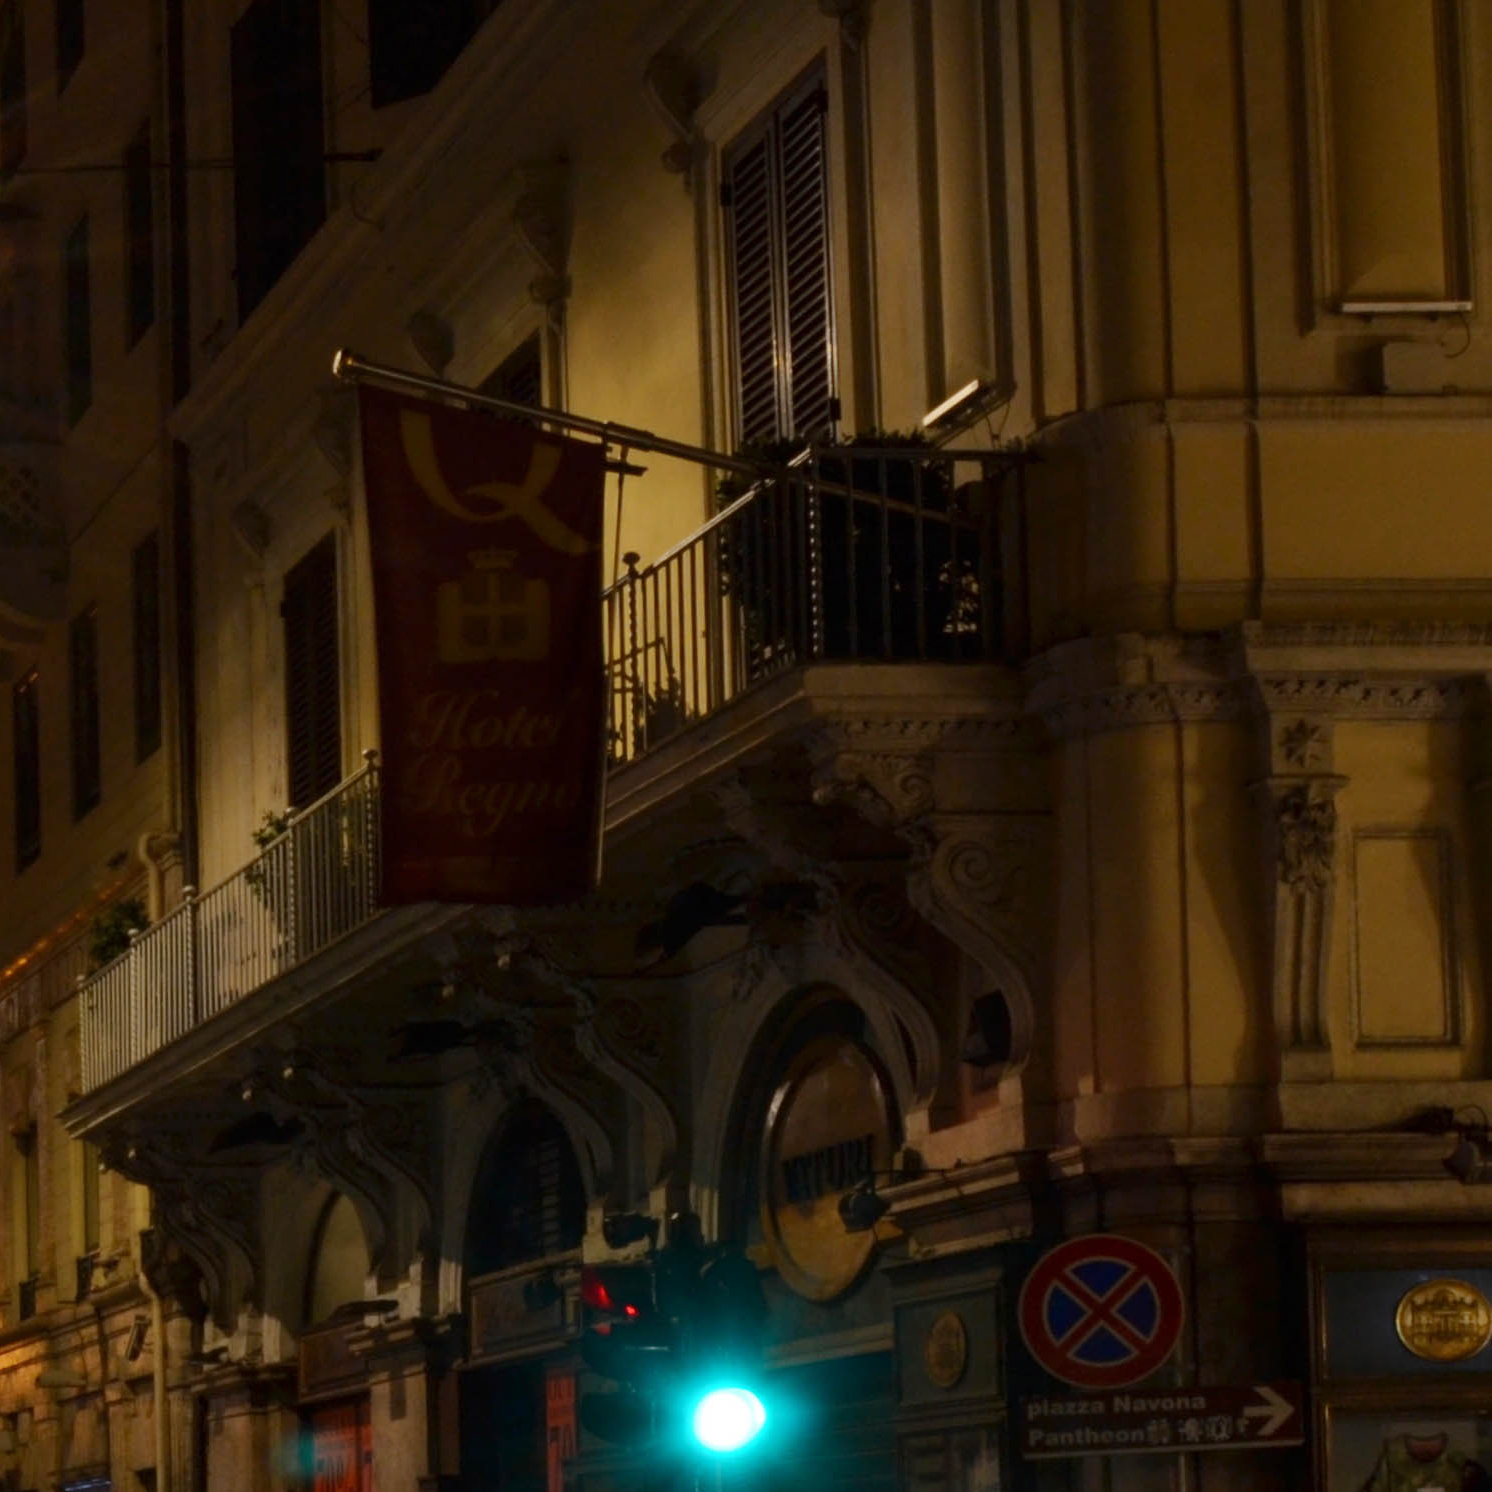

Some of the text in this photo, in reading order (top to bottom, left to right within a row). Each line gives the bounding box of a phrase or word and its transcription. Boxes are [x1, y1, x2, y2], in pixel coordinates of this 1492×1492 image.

[1027, 1394, 1207, 1421] piazza Navona
[1027, 1425, 1146, 1447] Pantheon
